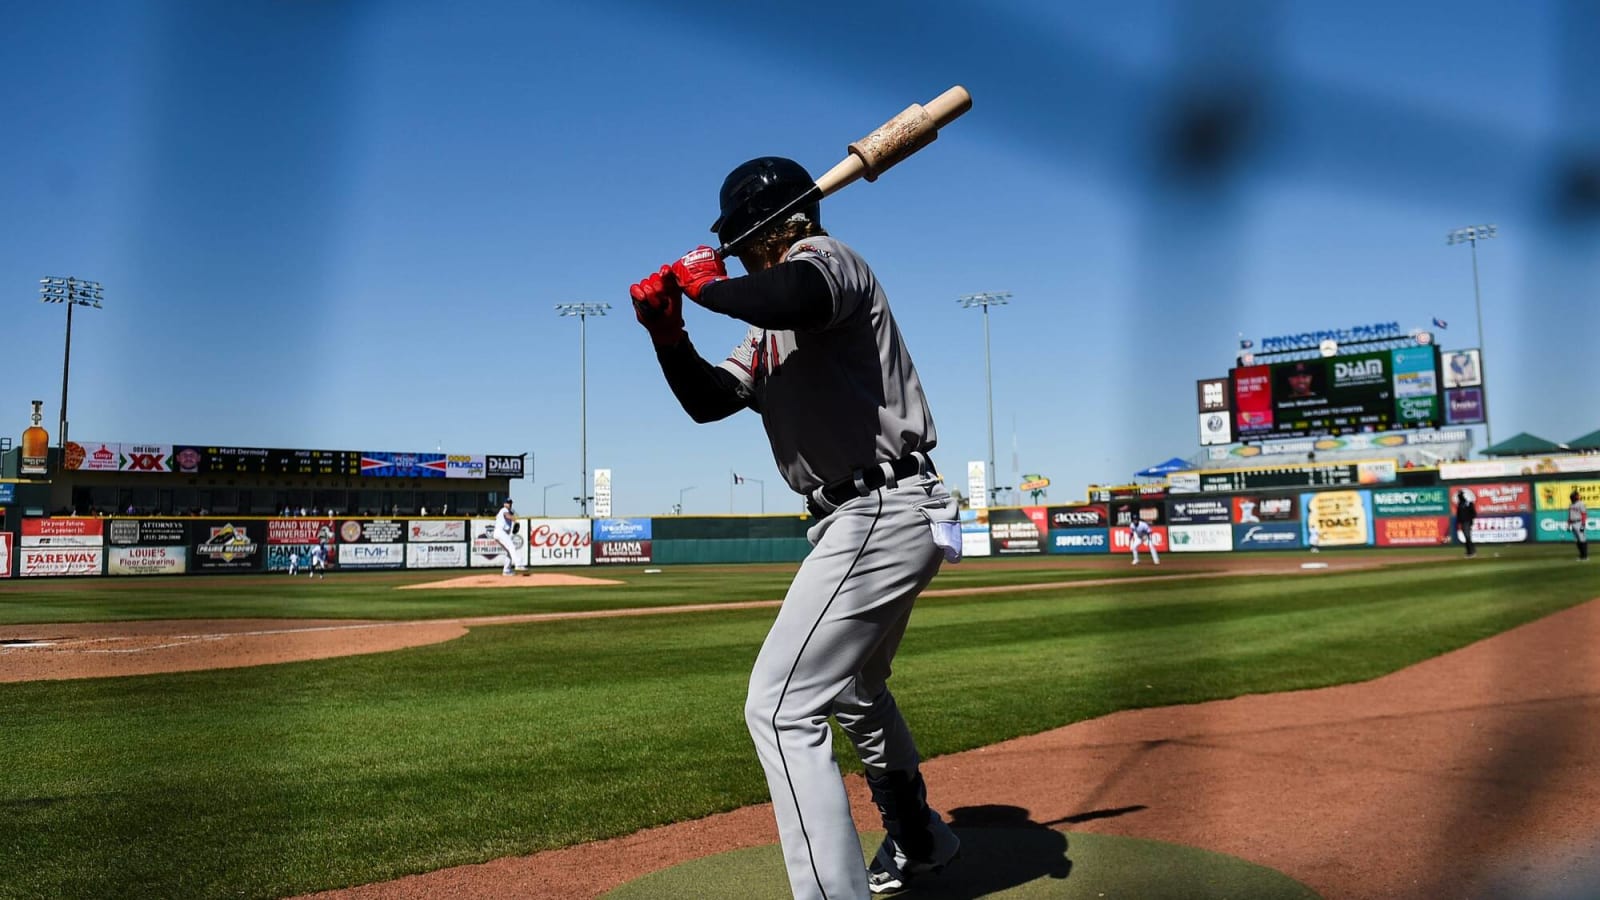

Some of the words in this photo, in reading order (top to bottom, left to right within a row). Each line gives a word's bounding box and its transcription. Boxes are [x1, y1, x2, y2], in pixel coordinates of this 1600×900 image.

[1262, 330, 1349, 348] PRINCIPAL
[1352, 322, 1399, 336] PARK
[1399, 399, 1432, 409] Great
[1402, 408, 1430, 419] Clips
[1374, 491, 1444, 504] MERCYONE
[1055, 512, 1099, 522] access
[1318, 518, 1358, 528] TOAST
[531, 524, 591, 547] Coors
[1056, 535, 1104, 546] SUPERCUTS
[269, 546, 310, 556] FAMILY
[355, 547, 388, 556] FMH
[609, 542, 642, 552] LUANA
[130, 549, 166, 557] LOUIE'S
[542, 548, 581, 559] LIGHT
[27, 554, 96, 564] FAREWAY
[142, 559, 175, 567] Covering
